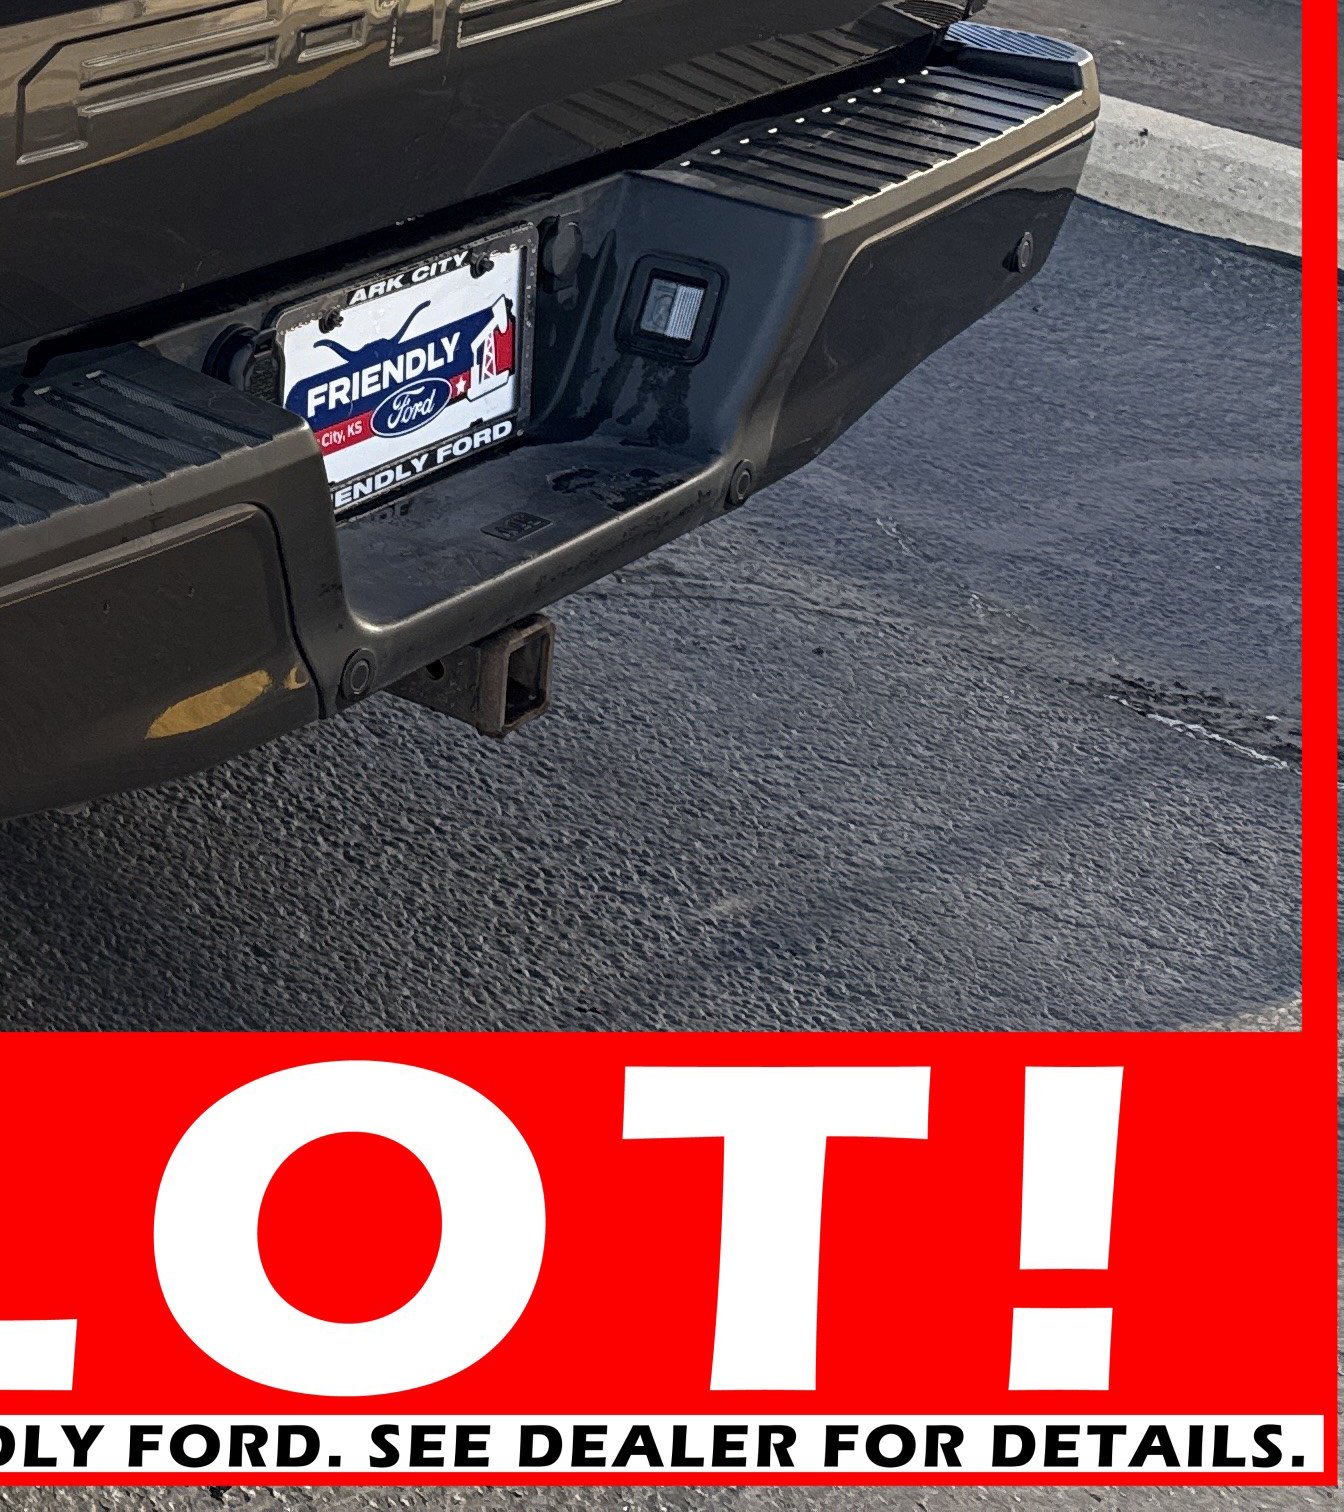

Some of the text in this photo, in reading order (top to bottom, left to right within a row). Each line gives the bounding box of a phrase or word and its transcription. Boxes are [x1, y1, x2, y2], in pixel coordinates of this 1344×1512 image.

[348, 250, 469, 306] ARK CITY
[306, 331, 461, 419] FRIENDLY
[321, 420, 363, 448] City, KS
[387, 386, 438, 429] Ford
[330, 420, 513, 509] ENDLY FORD
